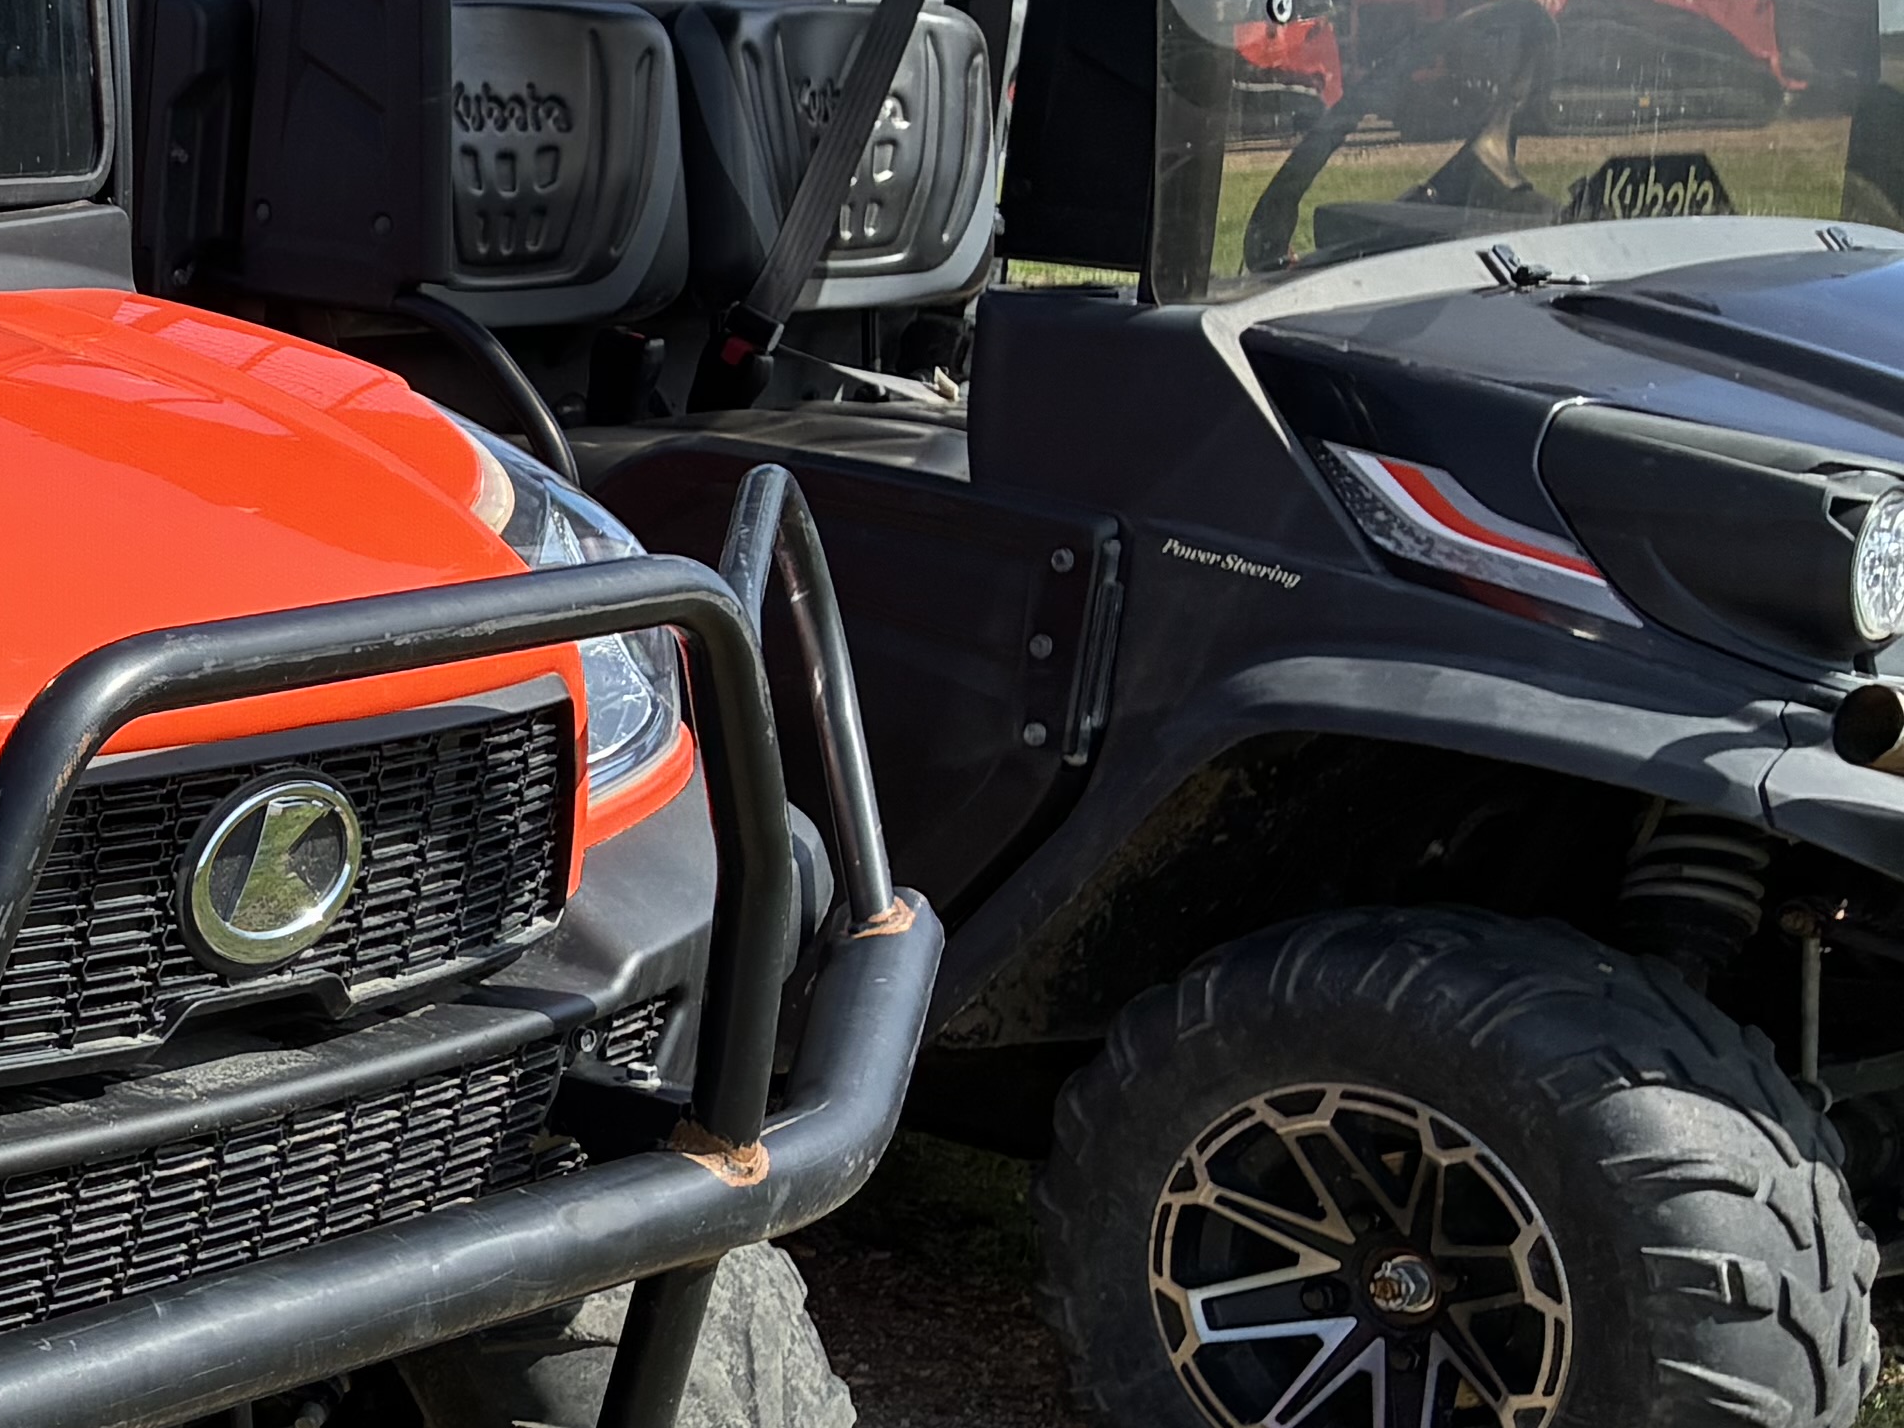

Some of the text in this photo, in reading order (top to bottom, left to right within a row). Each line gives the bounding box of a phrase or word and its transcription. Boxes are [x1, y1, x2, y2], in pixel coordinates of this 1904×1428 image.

[1603, 164, 1714, 220] Kubota
[1162, 538, 1302, 589] Power Steering
